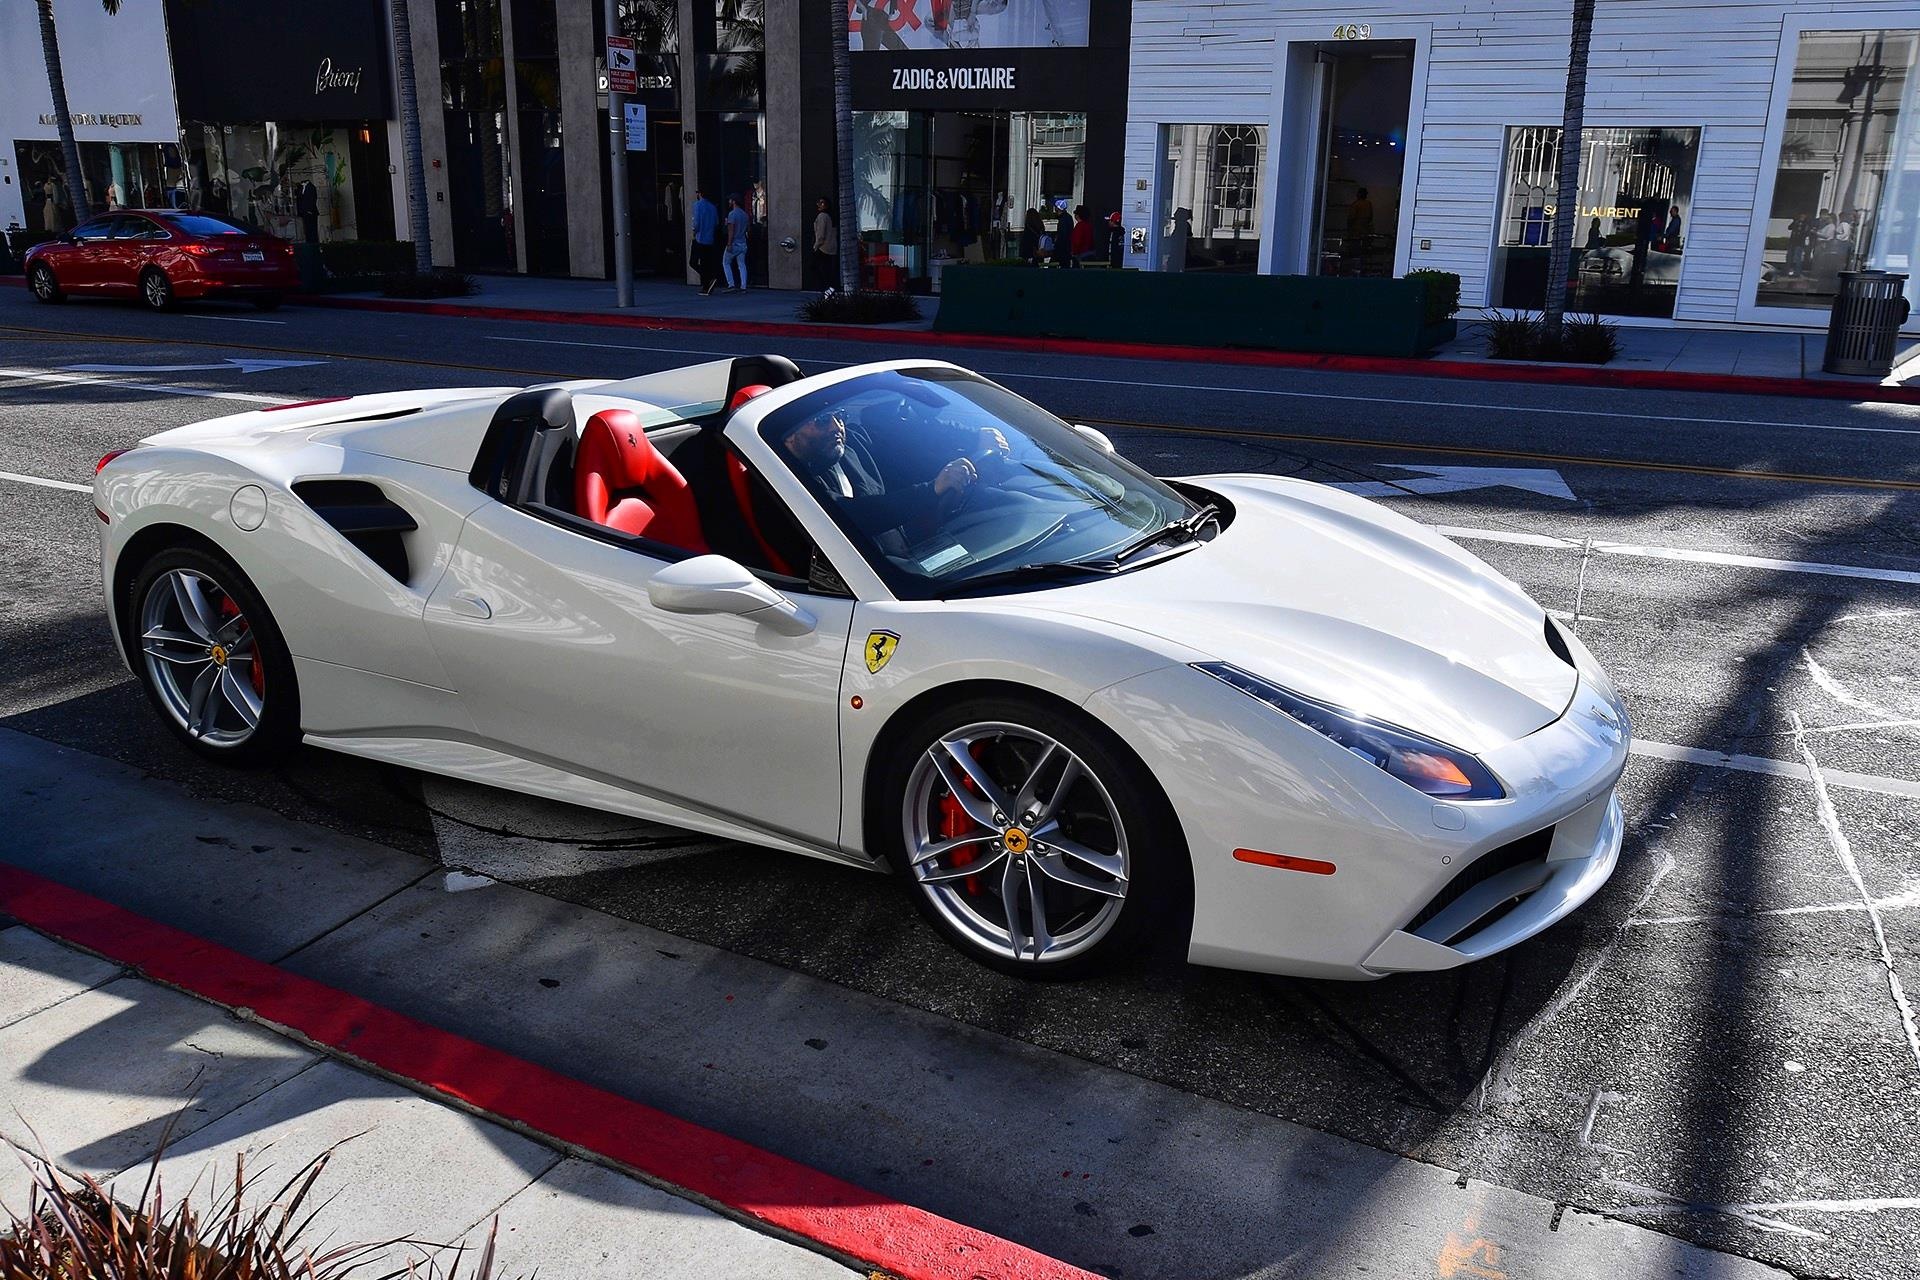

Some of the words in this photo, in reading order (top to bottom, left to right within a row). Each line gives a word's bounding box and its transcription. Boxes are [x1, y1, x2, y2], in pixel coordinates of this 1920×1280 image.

[1332, 24, 1371, 40] 469
[599, 75, 672, 90] DRED2
[892, 67, 1015, 90] ZADIG&VOLTAIRE
[1582, 206, 1641, 218] LAURENT
